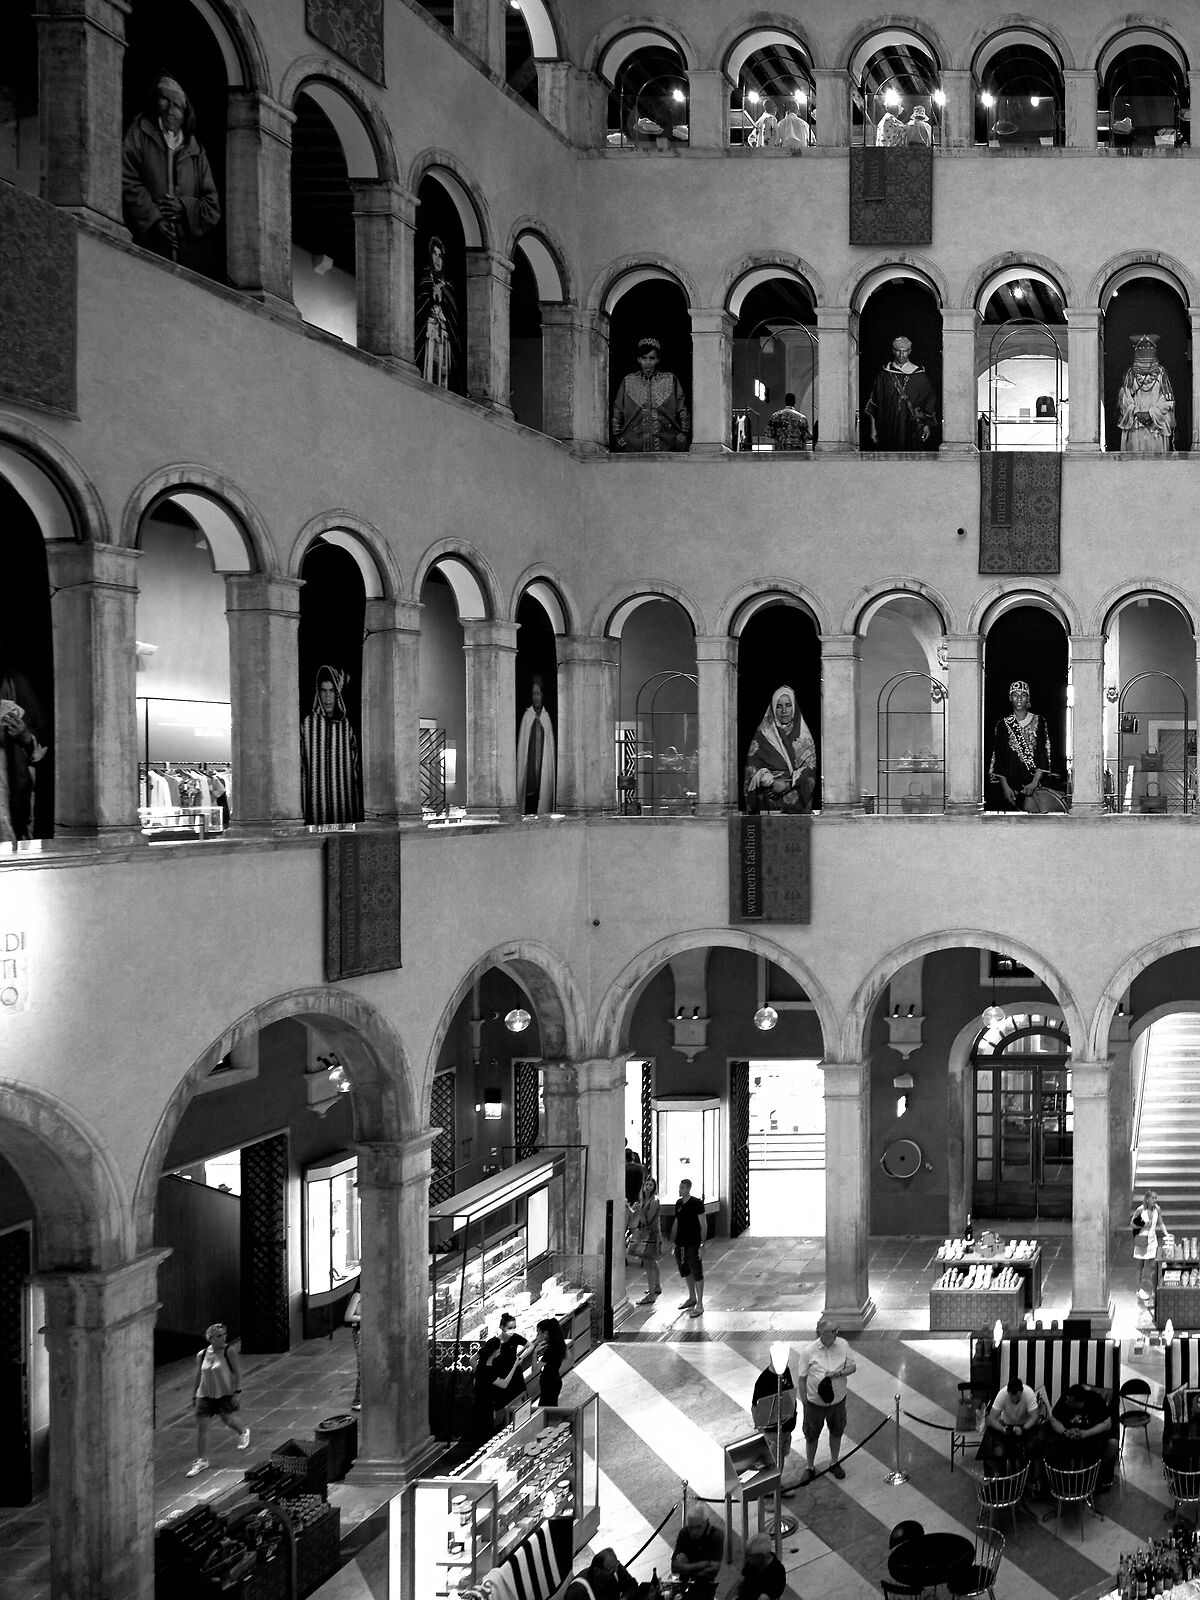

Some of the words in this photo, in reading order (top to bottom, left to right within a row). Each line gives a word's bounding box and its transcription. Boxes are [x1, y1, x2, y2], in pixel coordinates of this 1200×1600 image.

[996, 458, 1007, 490] shoes
[995, 494, 1006, 522] men's
[745, 824, 756, 865] fashion
[745, 866, 756, 914] women's
